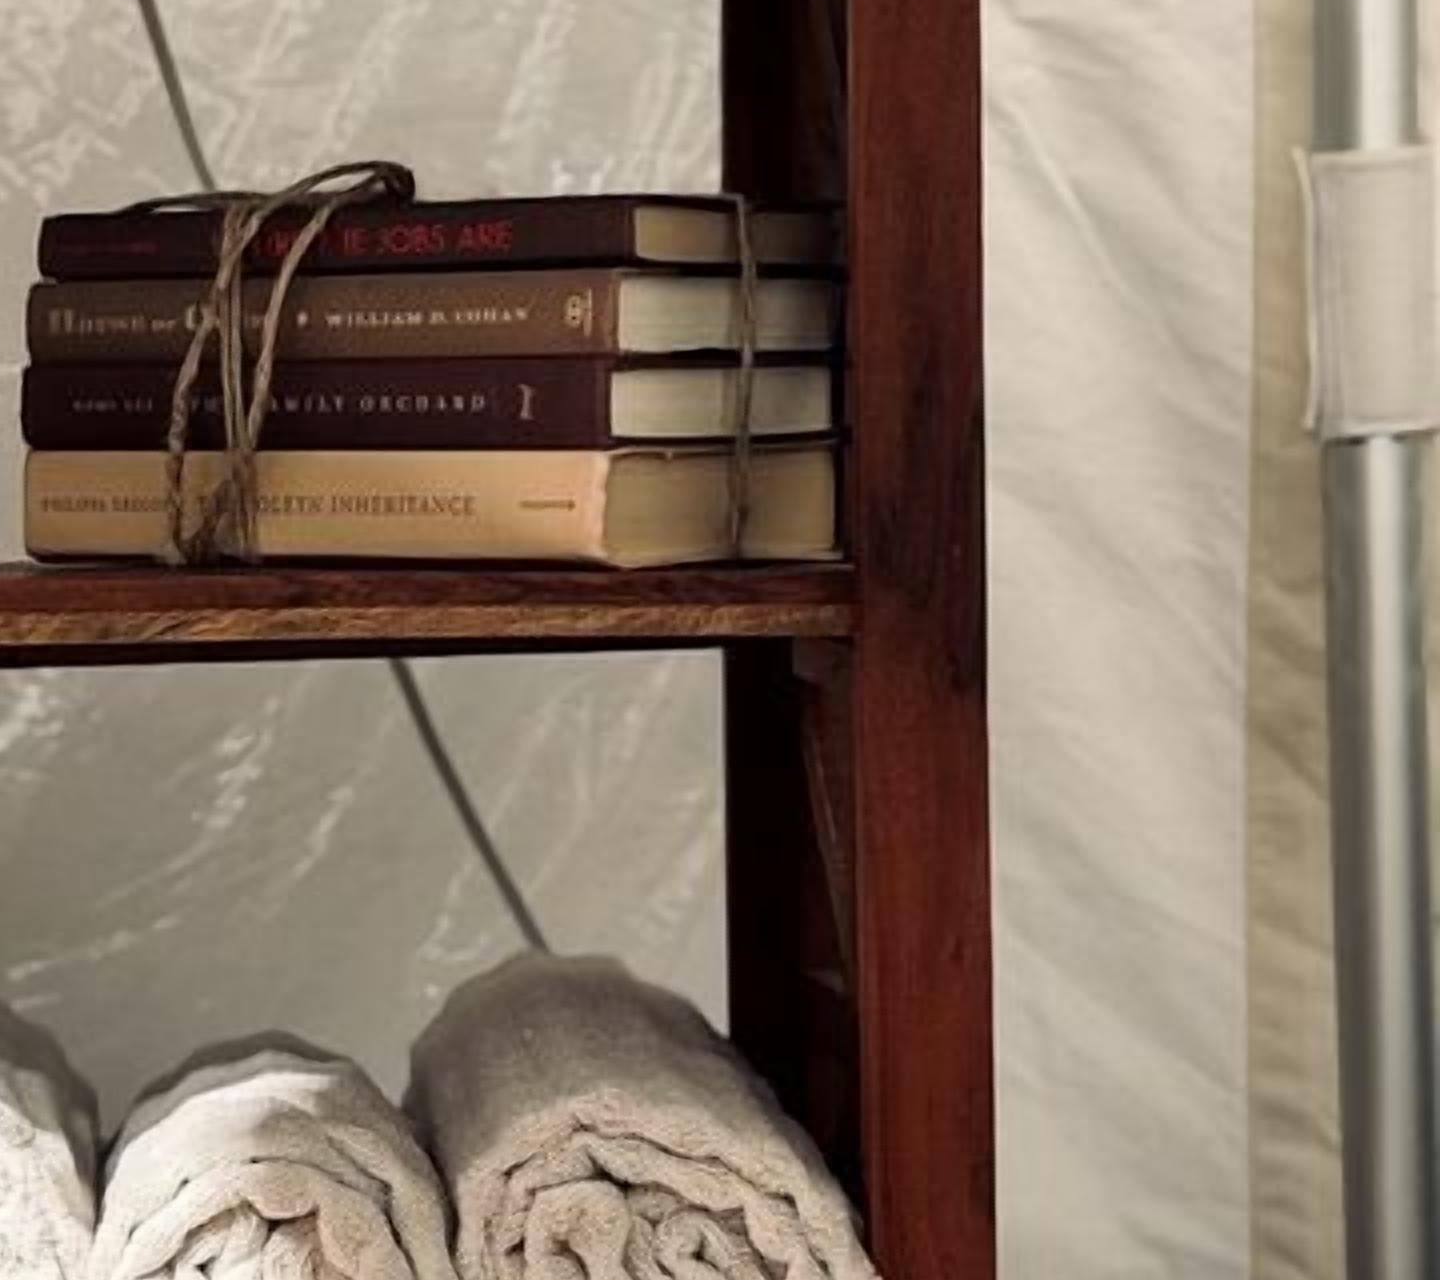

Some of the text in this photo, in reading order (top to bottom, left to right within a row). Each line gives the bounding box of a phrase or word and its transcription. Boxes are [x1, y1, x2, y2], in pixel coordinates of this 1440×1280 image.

[326, 310, 422, 326] WILLIAM
[360, 394, 486, 413] ORCHARD
[331, 494, 478, 517] INHERITANCE
